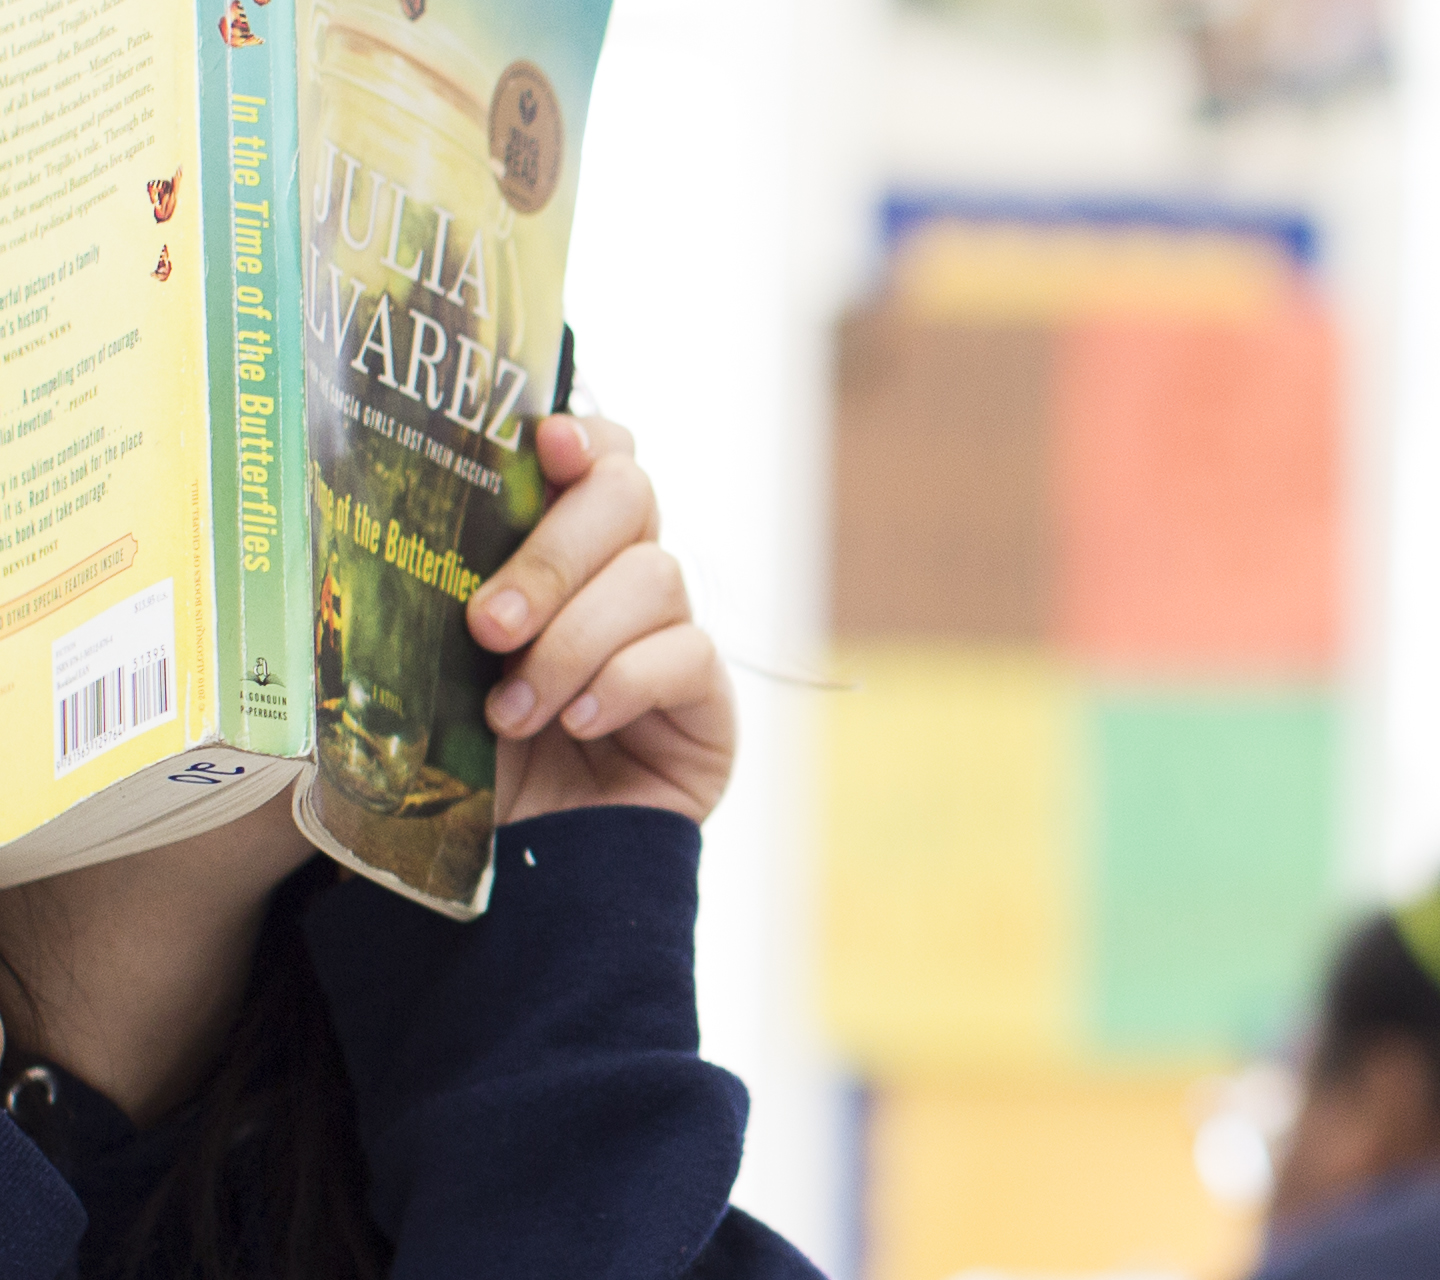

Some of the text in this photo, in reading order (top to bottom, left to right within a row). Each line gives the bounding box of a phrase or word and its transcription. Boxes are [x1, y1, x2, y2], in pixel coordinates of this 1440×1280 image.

[73, 25, 117, 56] Butterflies.
[126, 29, 152, 52] Patria,
[102, 56, 152, 93] tell their own
[124, 84, 154, 105] torture,
[104, 107, 153, 144] Through the
[110, 135, 154, 169] live again in
[314, 140, 491, 320] JULIA
[24, 272, 55, 302] picture
[58, 262, 65, 282] of
[69, 262, 73, 276] a
[76, 245, 99, 271] family
[16, 296, 55, 331] history."
[232, 93, 277, 573] In the Time of the Butterflies
[3, 336, 45, 364] MORNING
[49, 322, 71, 340] NEWS
[307, 244, 529, 452] LVAREZ
[21, 389, 27, 405] A
[30, 367, 74, 403] compelling
[76, 354, 95, 378] story
[98, 343, 105, 364] of
[107, 328, 141, 358] courage,
[16, 400, 60, 438] devotion."
[9, 474, 17, 490] in
[20, 457, 54, 486] sublime
[56, 426, 105, 467] combination
[363, 405, 395, 439] GIRLS
[397, 423, 424, 452] LOST
[425, 436, 454, 469] THEIR
[454, 456, 502, 496] ACCENTS
[3, 502, 11, 522] it
[14, 500, 25, 515] is.
[28, 485, 49, 509] Read
[52, 474, 67, 496] this
[70, 460, 87, 486] book
[90, 455, 102, 473] for
[105, 445, 117, 464] the
[120, 431, 143, 459] place
[190, 478, 200, 507] HILL
[15, 520, 34, 544] book
[38, 509, 52, 533] and
[55, 501, 72, 523] take
[74, 473, 112, 512] courage."
[191, 510, 201, 552] CHAPEL
[336, 493, 352, 534] of
[354, 503, 381, 554] the
[385, 518, 482, 603] Butterflies
[2, 552, 35, 577] DENVER
[39, 539, 58, 559] POST
[193, 554, 202, 572] OF
[6, 602, 30, 627] OTHER
[33, 585, 61, 613] SPECIAL
[64, 563, 97, 595] FEATURES
[100, 548, 124, 572] INSIDE
[195, 576, 204, 610] BOOKS
[196, 613, 206, 675] ALGONQUIN
[197, 676, 206, 699] 2010
[240, 691, 288, 706] AGONQUIN
